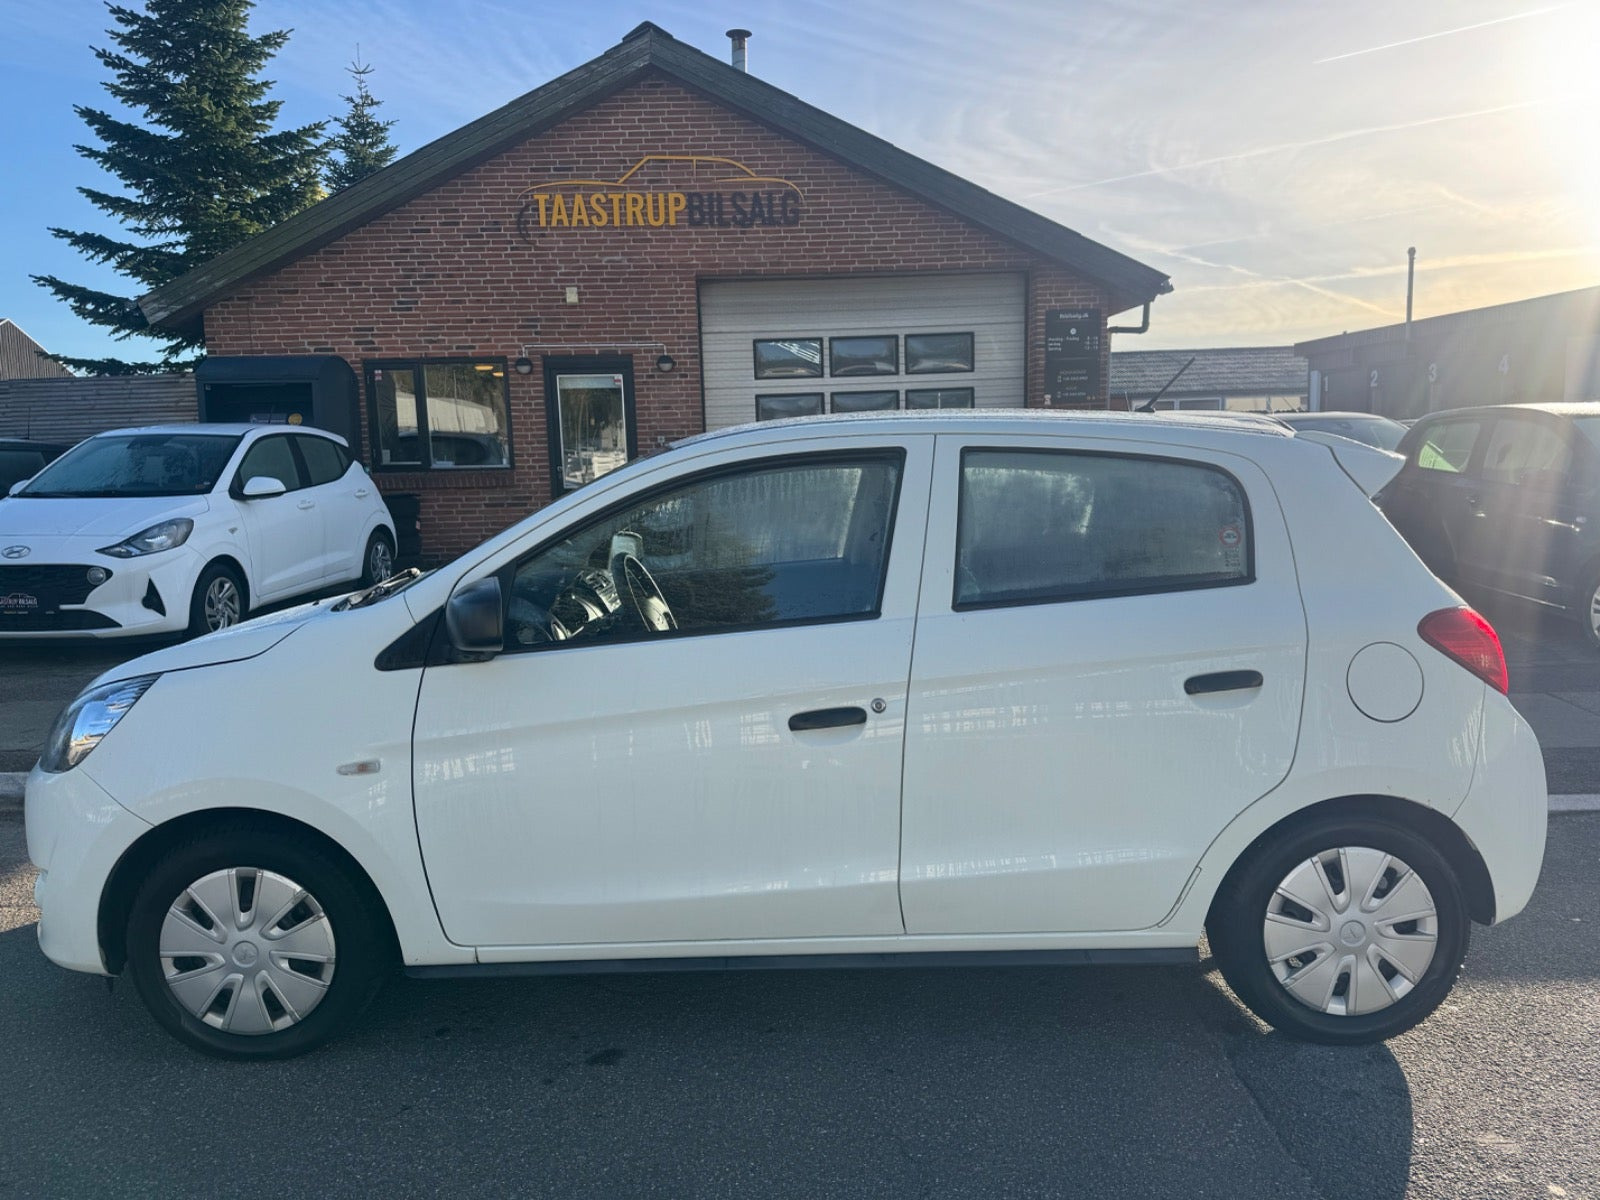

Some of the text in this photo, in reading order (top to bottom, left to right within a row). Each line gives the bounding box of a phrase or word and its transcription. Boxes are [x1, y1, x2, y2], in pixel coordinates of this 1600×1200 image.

[1428, 363, 1438, 382] 3
[1498, 354, 1510, 376] 4
[1323, 375, 1329, 392] 1
[1369, 369, 1379, 387] 2
